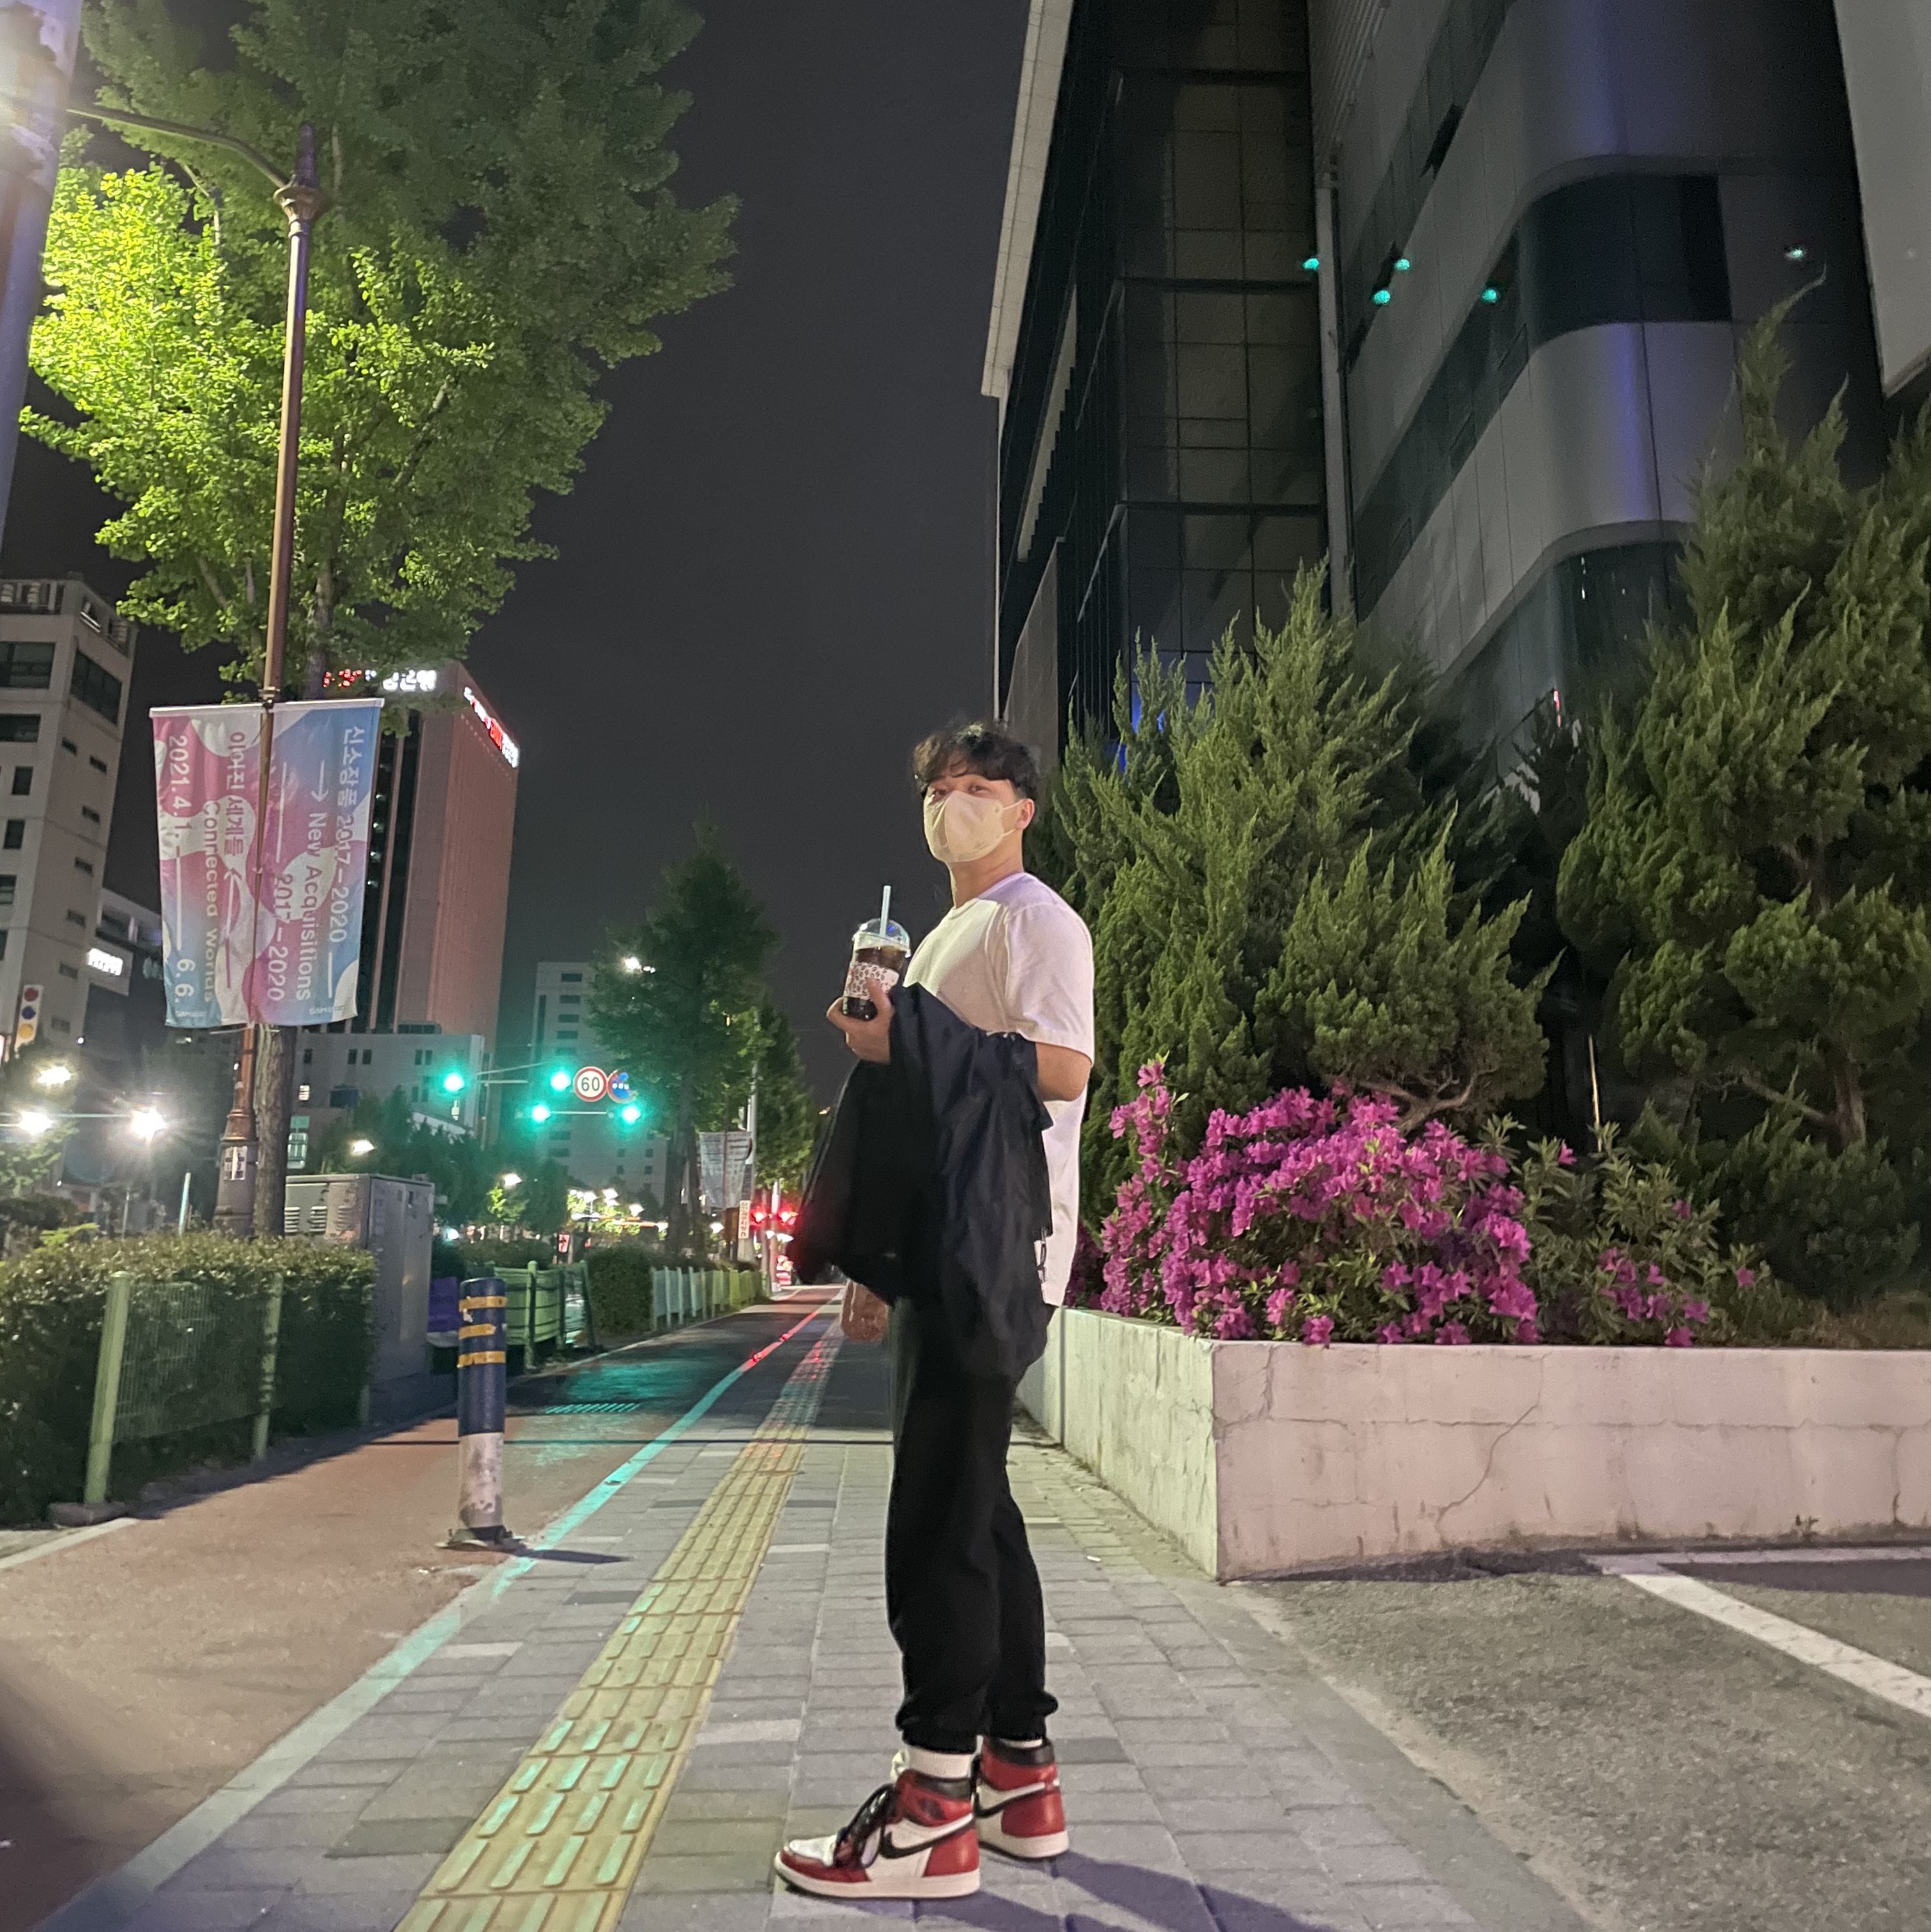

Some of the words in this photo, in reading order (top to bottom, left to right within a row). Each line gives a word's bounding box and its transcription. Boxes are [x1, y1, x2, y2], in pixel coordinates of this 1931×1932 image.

[227, 731, 246, 790] 이어진
[338, 726, 365, 807] 신소장품
[224, 796, 244, 856] 세계들
[307, 812, 328, 857] New
[203, 801, 220, 917] Connected
[296, 865, 322, 1001] Acquisitions
[581, 1077, 600, 1092] 60
